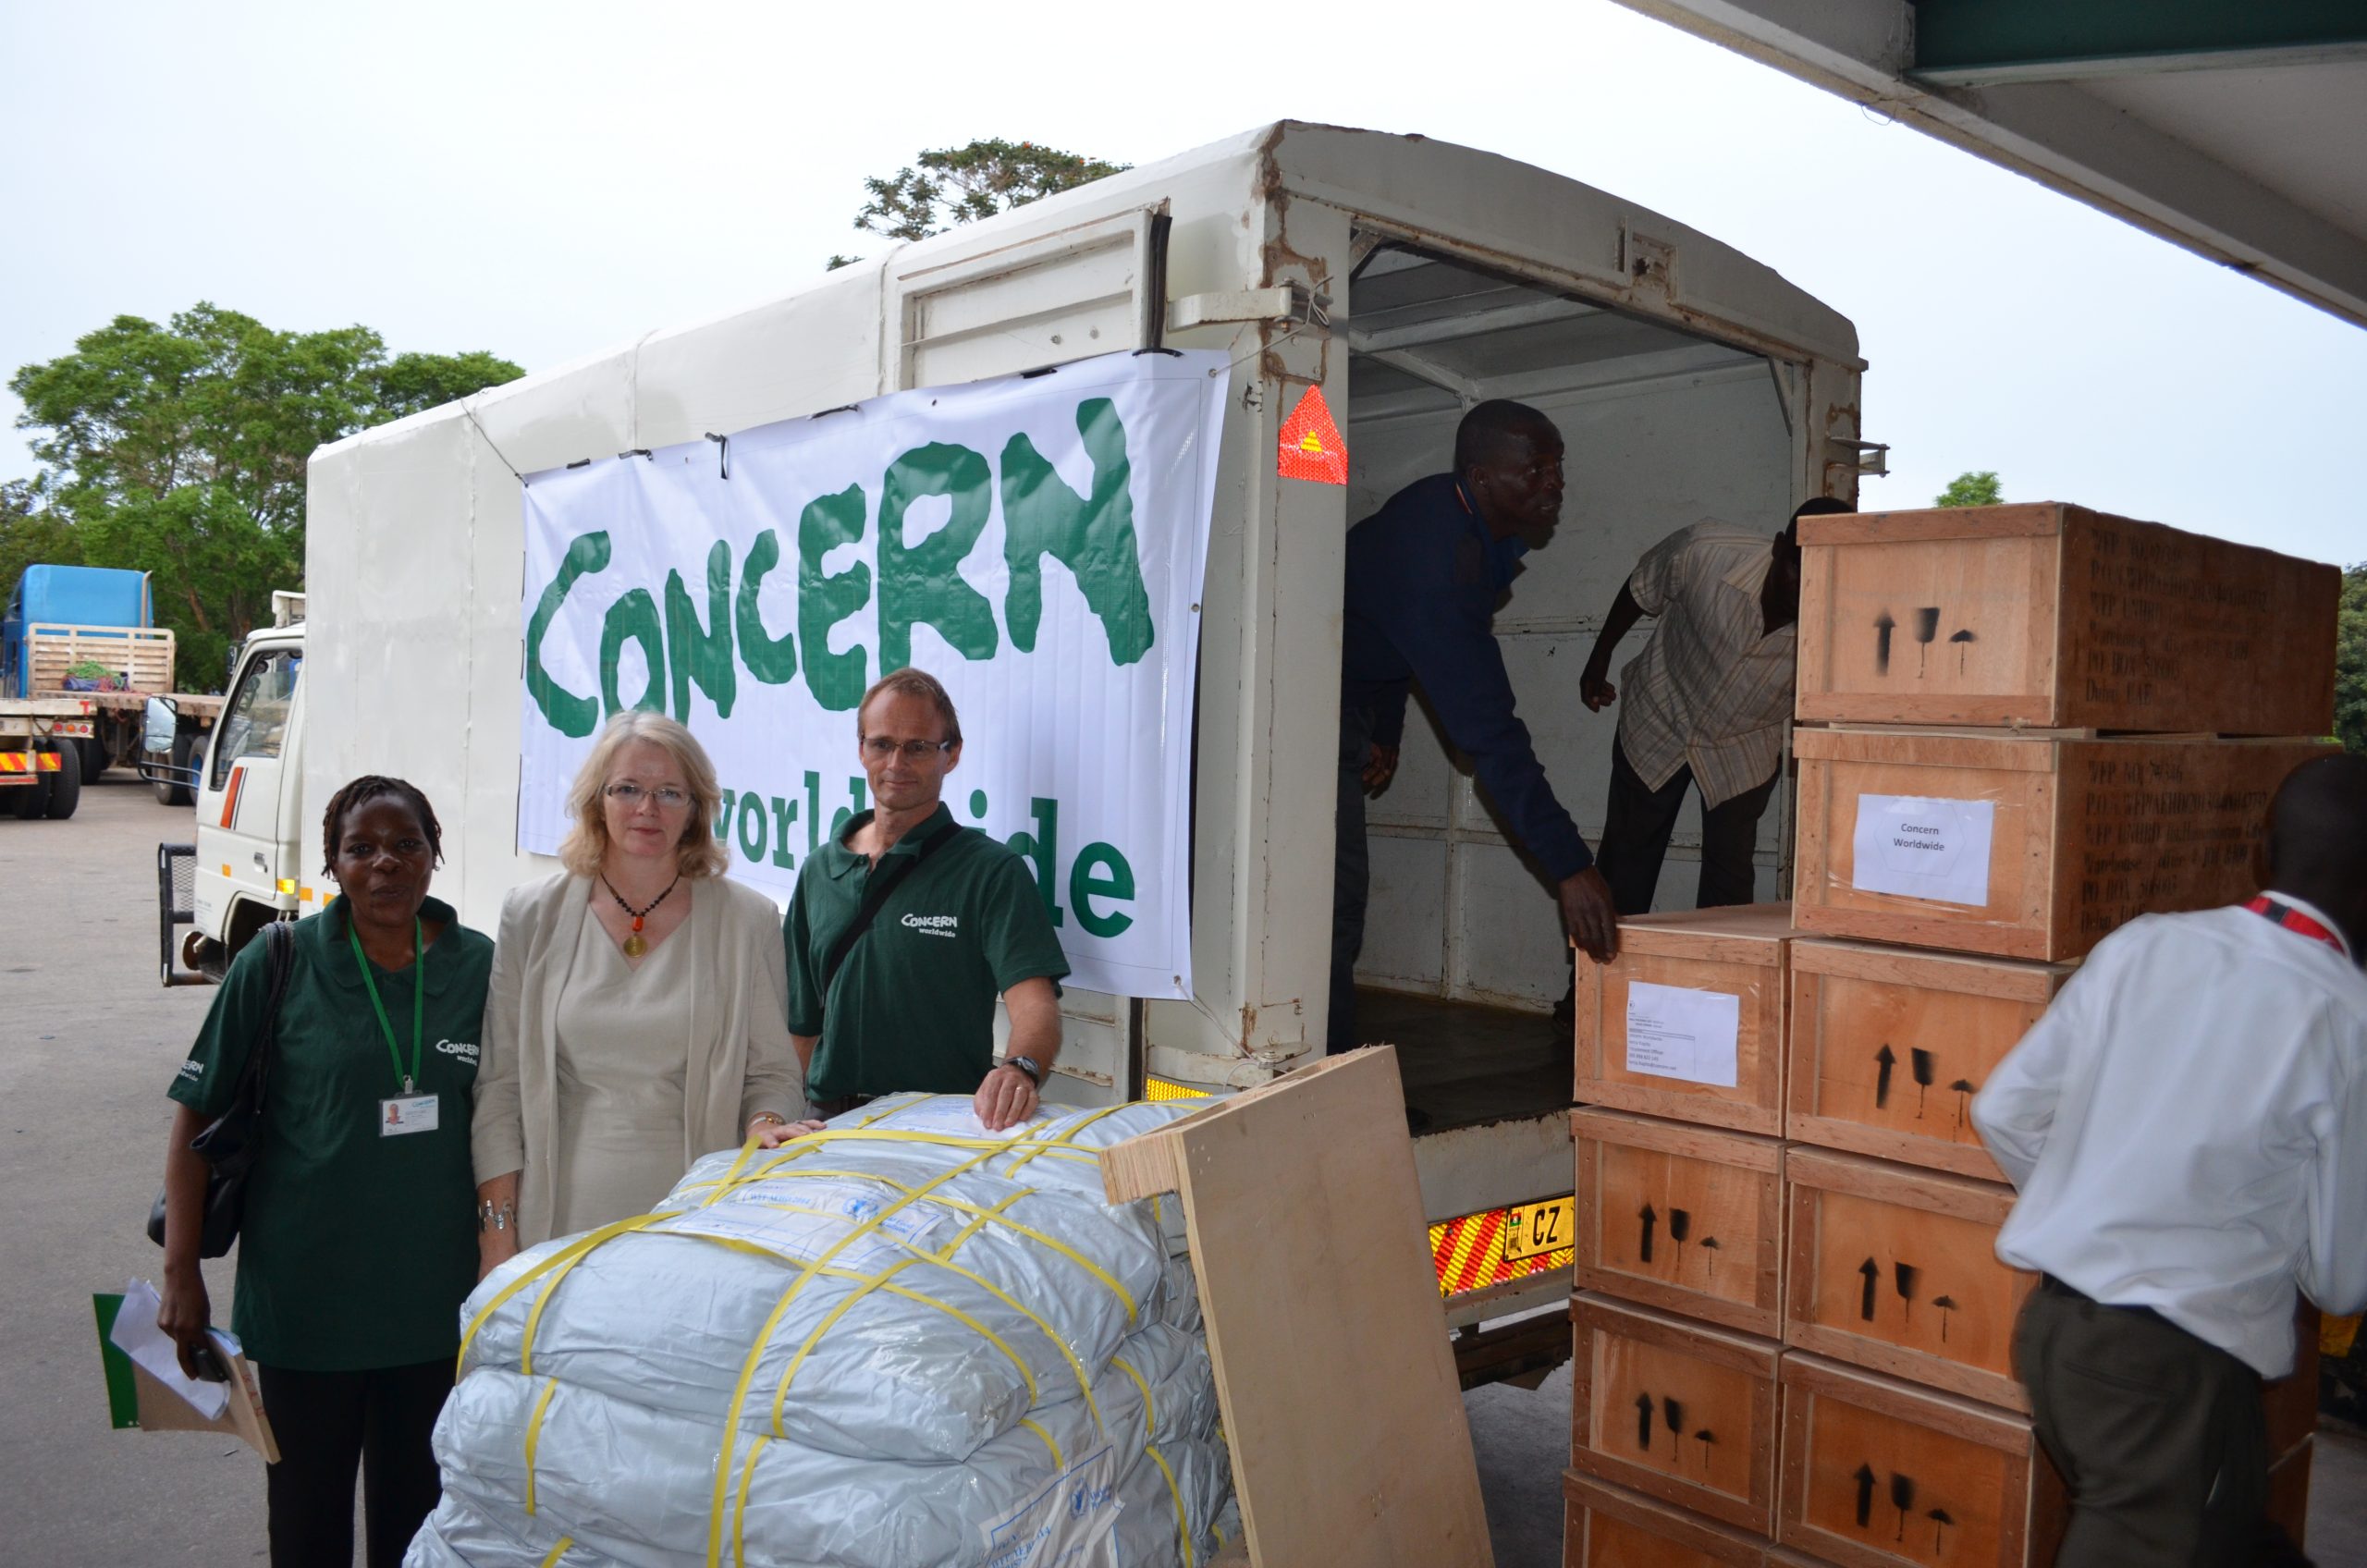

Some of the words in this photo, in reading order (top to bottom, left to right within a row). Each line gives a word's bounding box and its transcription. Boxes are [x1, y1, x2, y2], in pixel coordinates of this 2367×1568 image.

[527, 398, 1154, 738] CONCERN
[1901, 824, 1939, 835] Concern
[1894, 838, 1945, 851] Worldwide
[901, 913, 958, 928] CONCERN
[918, 927, 956, 938] worldwide
[1532, 1206, 1561, 1246] CZ
